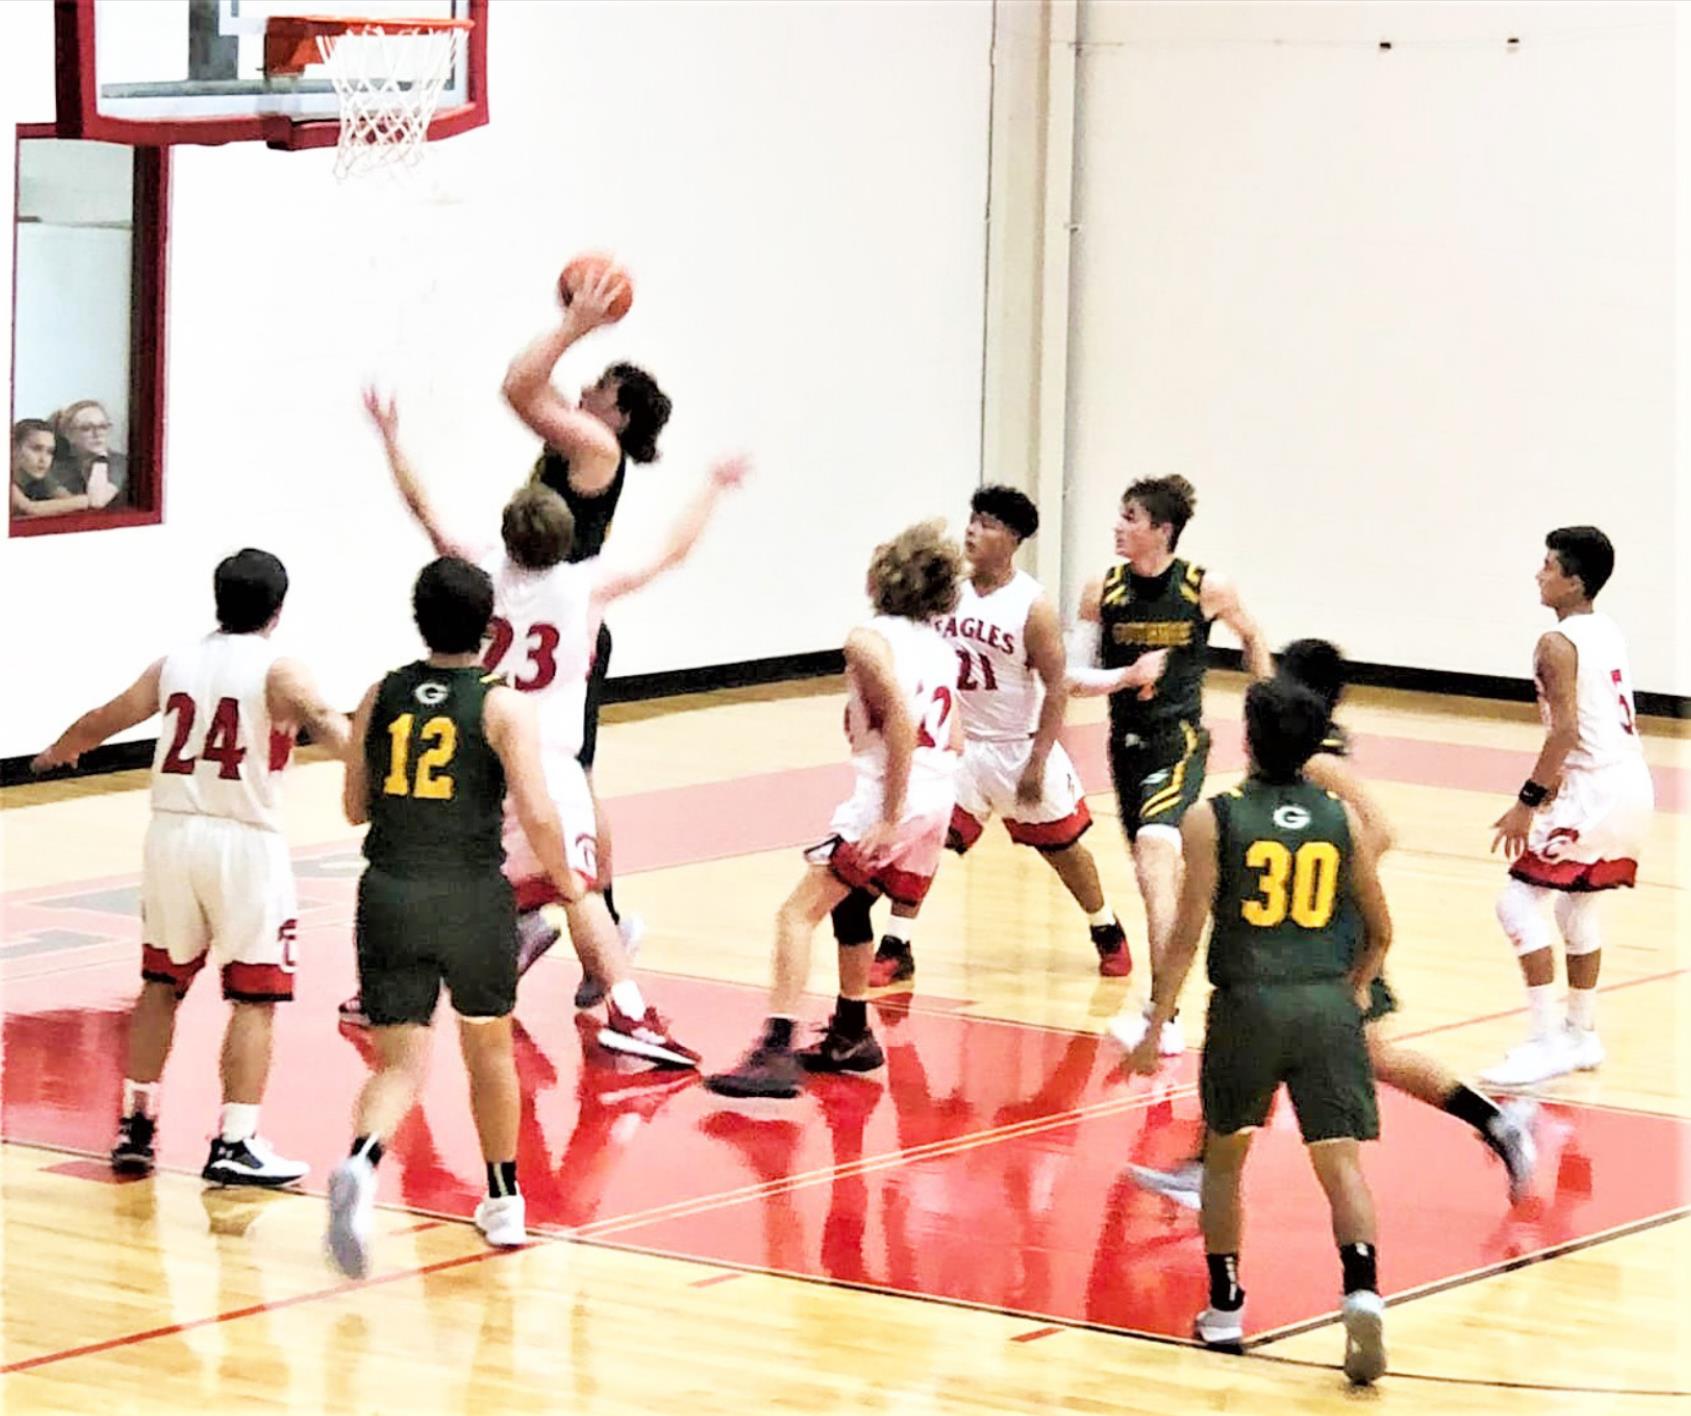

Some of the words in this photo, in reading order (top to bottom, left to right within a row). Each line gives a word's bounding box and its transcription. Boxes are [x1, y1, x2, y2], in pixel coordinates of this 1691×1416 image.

[481, 615, 560, 692] 23
[956, 648, 998, 691] 21
[161, 691, 247, 781] 24
[383, 712, 458, 800] 12
[1273, 805, 1311, 829] G
[1241, 840, 1340, 929] 30
